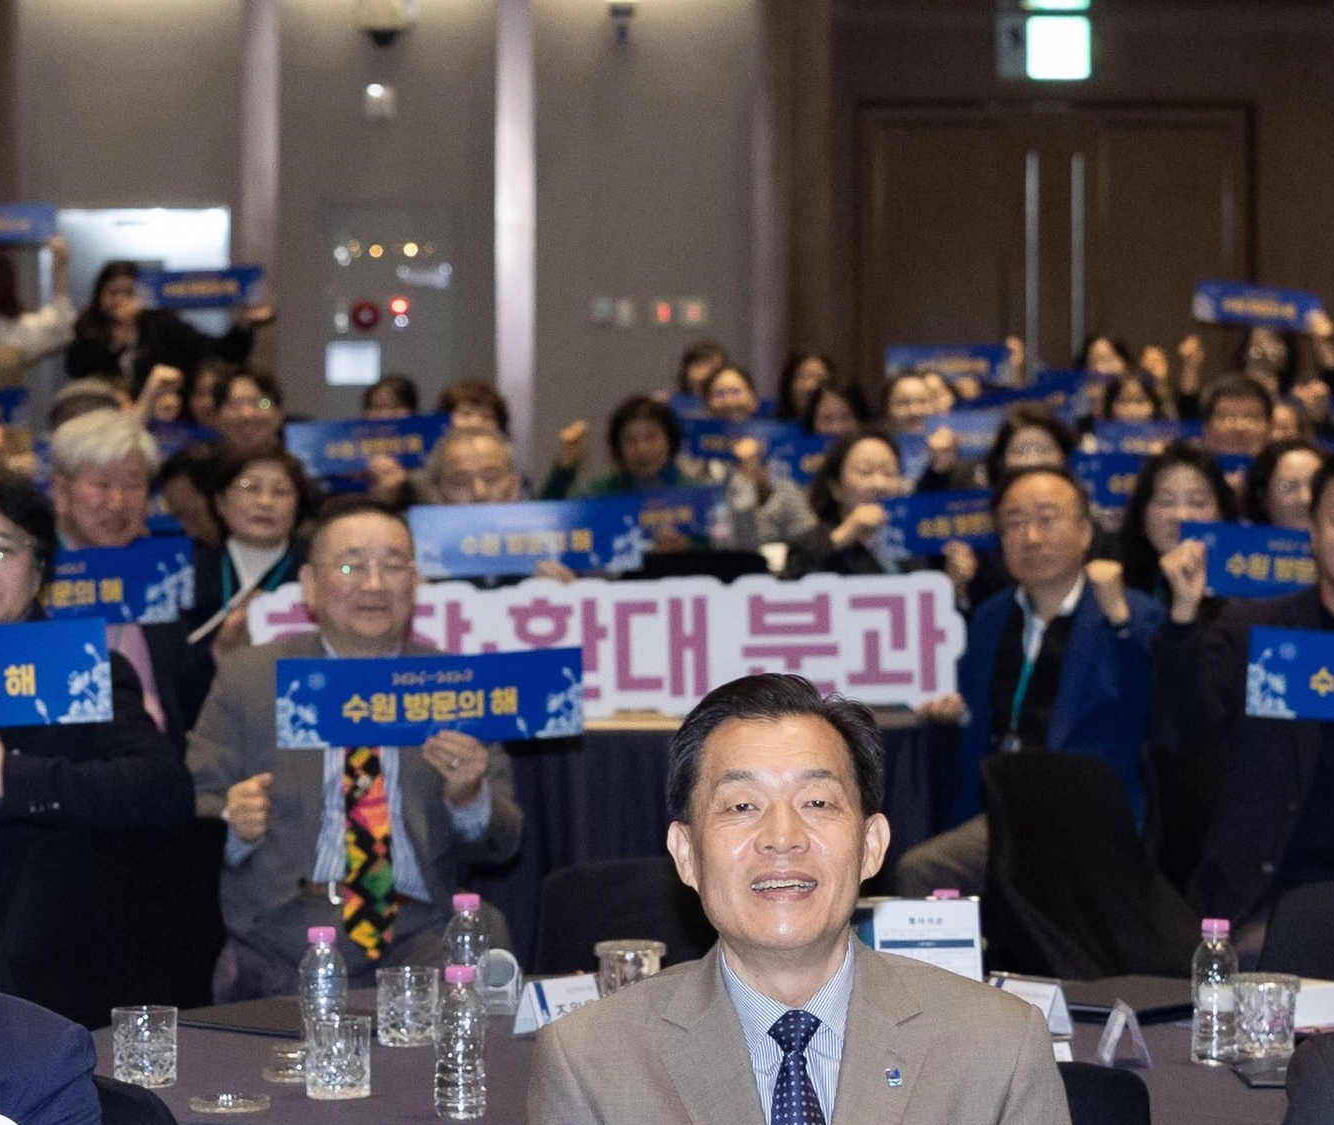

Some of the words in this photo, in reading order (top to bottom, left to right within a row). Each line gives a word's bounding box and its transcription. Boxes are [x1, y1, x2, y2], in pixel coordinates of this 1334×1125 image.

[741, 591, 947, 695] 분과
[4, 663, 36, 698] 해
[342, 692, 398, 724] 수원
[403, 688, 484, 723] 방문의
[490, 685, 519, 716] 해
